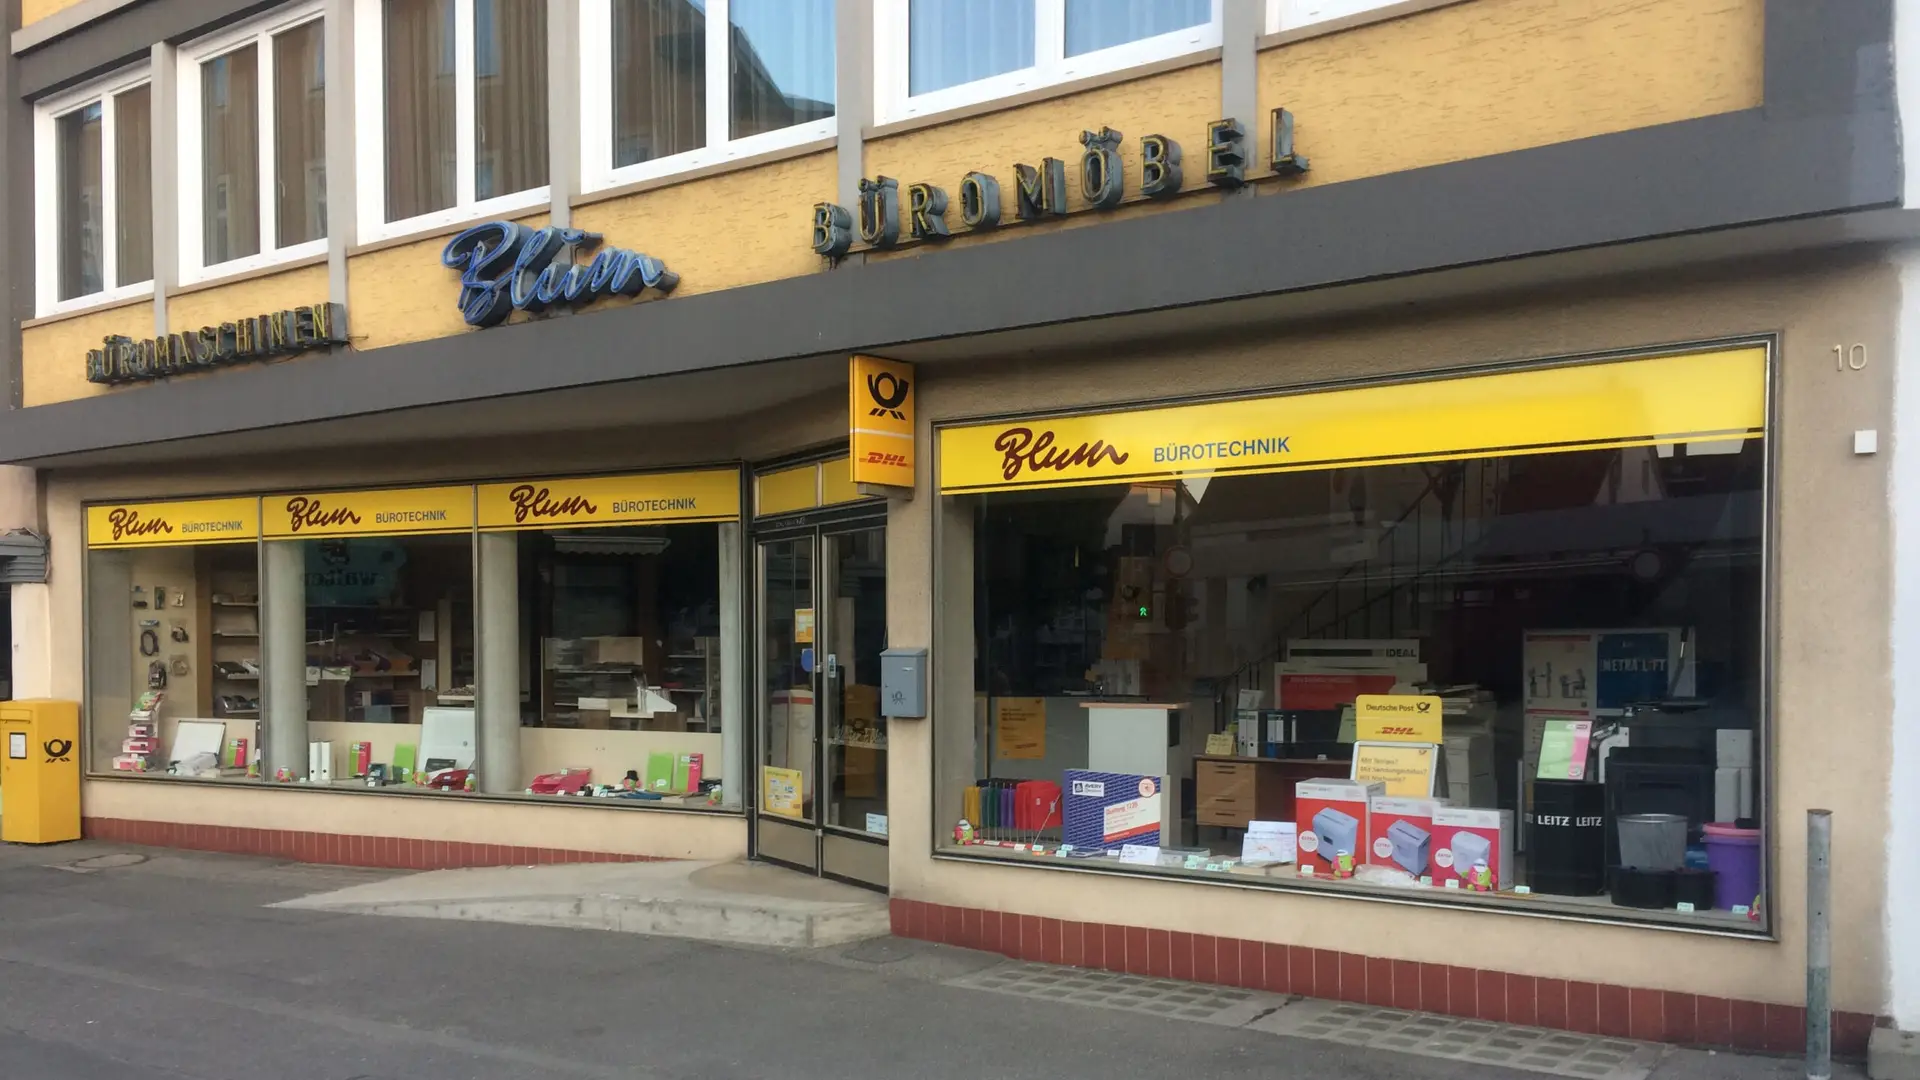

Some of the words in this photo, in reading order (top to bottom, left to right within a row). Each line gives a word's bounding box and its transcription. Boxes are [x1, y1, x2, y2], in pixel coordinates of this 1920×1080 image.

[812, 107, 1310, 256] BÜROMÖBEL
[441, 222, 680, 328] Blum
[85, 301, 348, 383] BÜROMASCHINEN
[1832, 342, 1868, 372] 10
[864, 451, 911, 468] DHL
[994, 427, 1130, 481] Blum
[1153, 436, 1291, 464] BÜROTECHNIK
[286, 495, 362, 532] Blum
[374, 509, 448, 525] BÜROTECHNIK
[508, 484, 598, 524] Blum
[611, 496, 697, 514] BÜROTECHNIK
[108, 507, 174, 541] Blum
[181, 520, 244, 534] BÜROTECHNIK
[1385, 647, 1417, 658] IDEAL
[1365, 703, 1398, 712] Deutsche
[1399, 704, 1415, 712] Post
[1380, 726, 1416, 736] DHL
[1537, 814, 1571, 828] LEITZ
[1575, 815, 1603, 828] LEITZ
